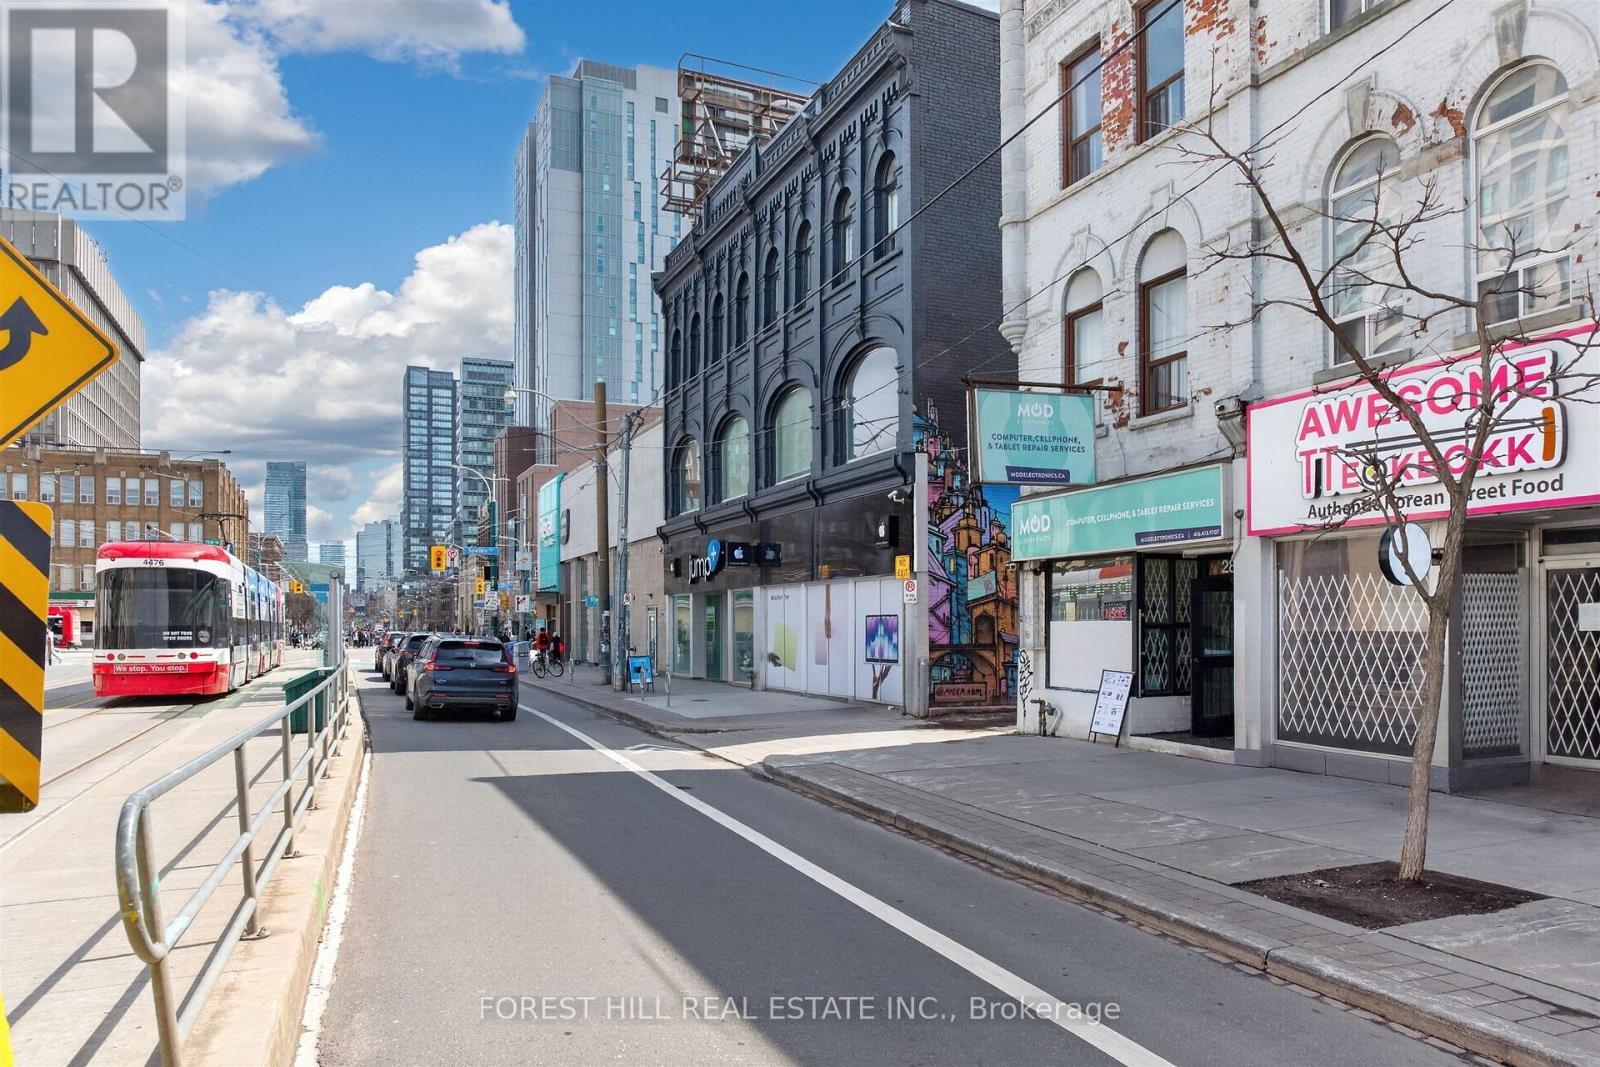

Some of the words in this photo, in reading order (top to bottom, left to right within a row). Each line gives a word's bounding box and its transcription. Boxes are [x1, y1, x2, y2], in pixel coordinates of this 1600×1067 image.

[1300, 356, 1547, 441] AWESOME
[995, 443, 1021, 451] TABLET
[1051, 445, 1086, 453] SERVICES
[1512, 473, 1564, 496] Food
[1137, 506, 1158, 517] TABLET
[1159, 503, 1182, 513] REPAIR
[1182, 498, 1215, 511] SERVICES
[897, 569, 908, 577] EXIT
